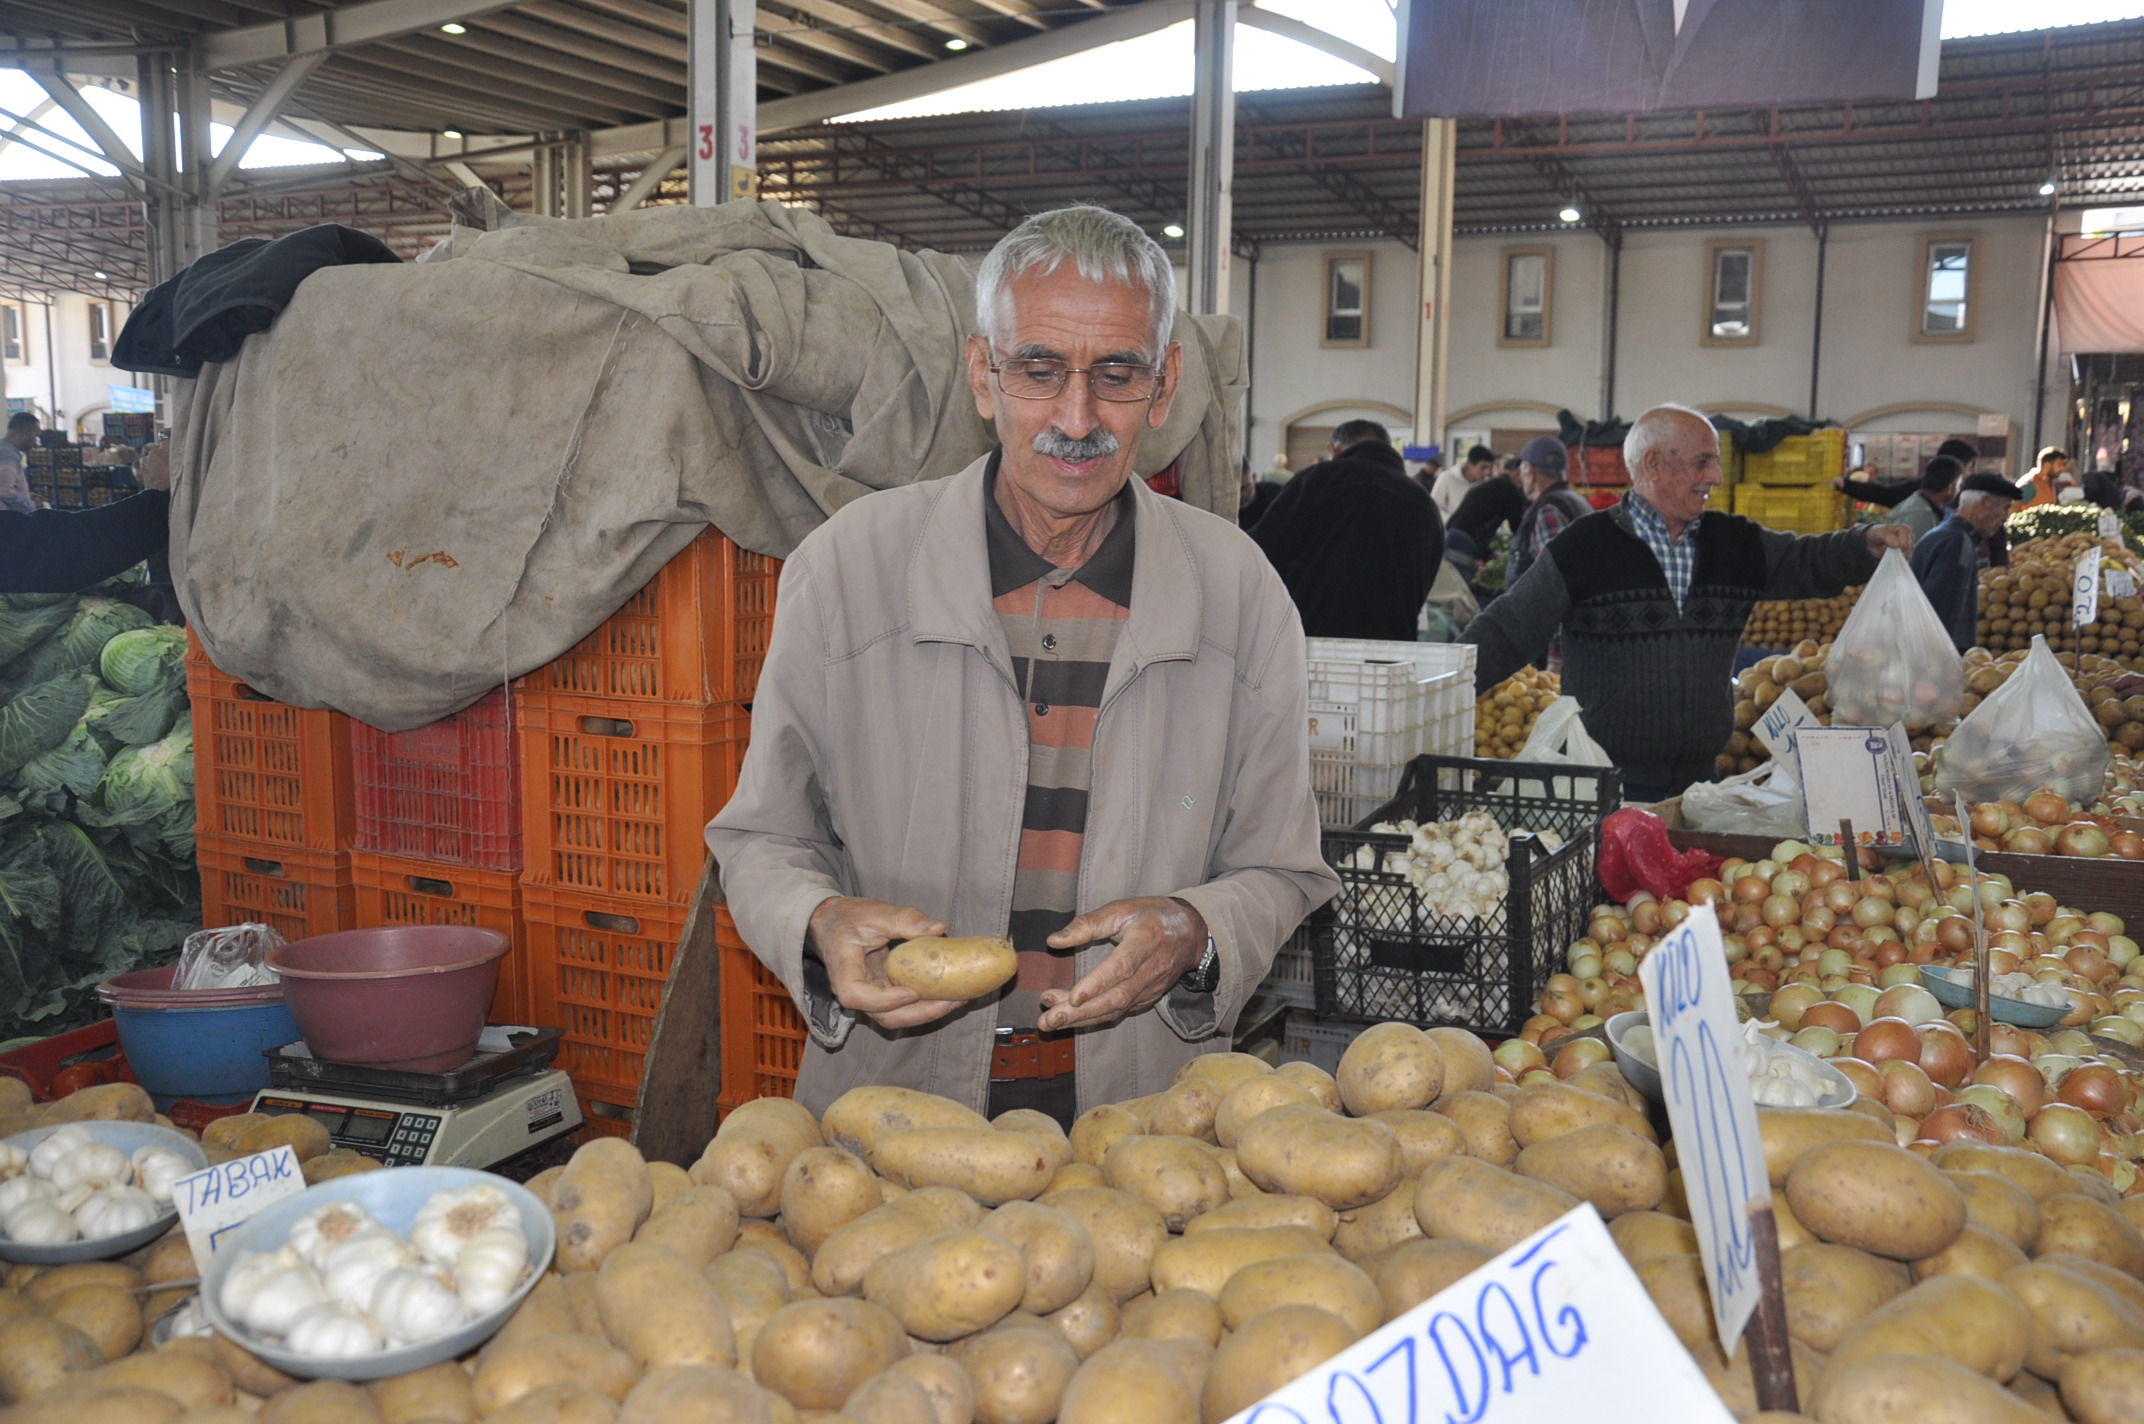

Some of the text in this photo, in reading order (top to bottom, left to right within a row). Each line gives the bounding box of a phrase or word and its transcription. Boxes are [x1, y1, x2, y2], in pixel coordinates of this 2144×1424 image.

[698, 124, 714, 160] 3
[738, 124, 749, 160] 3
[1425, 301, 1432, 320] 1
[174, 1150, 292, 1215] TABAK
